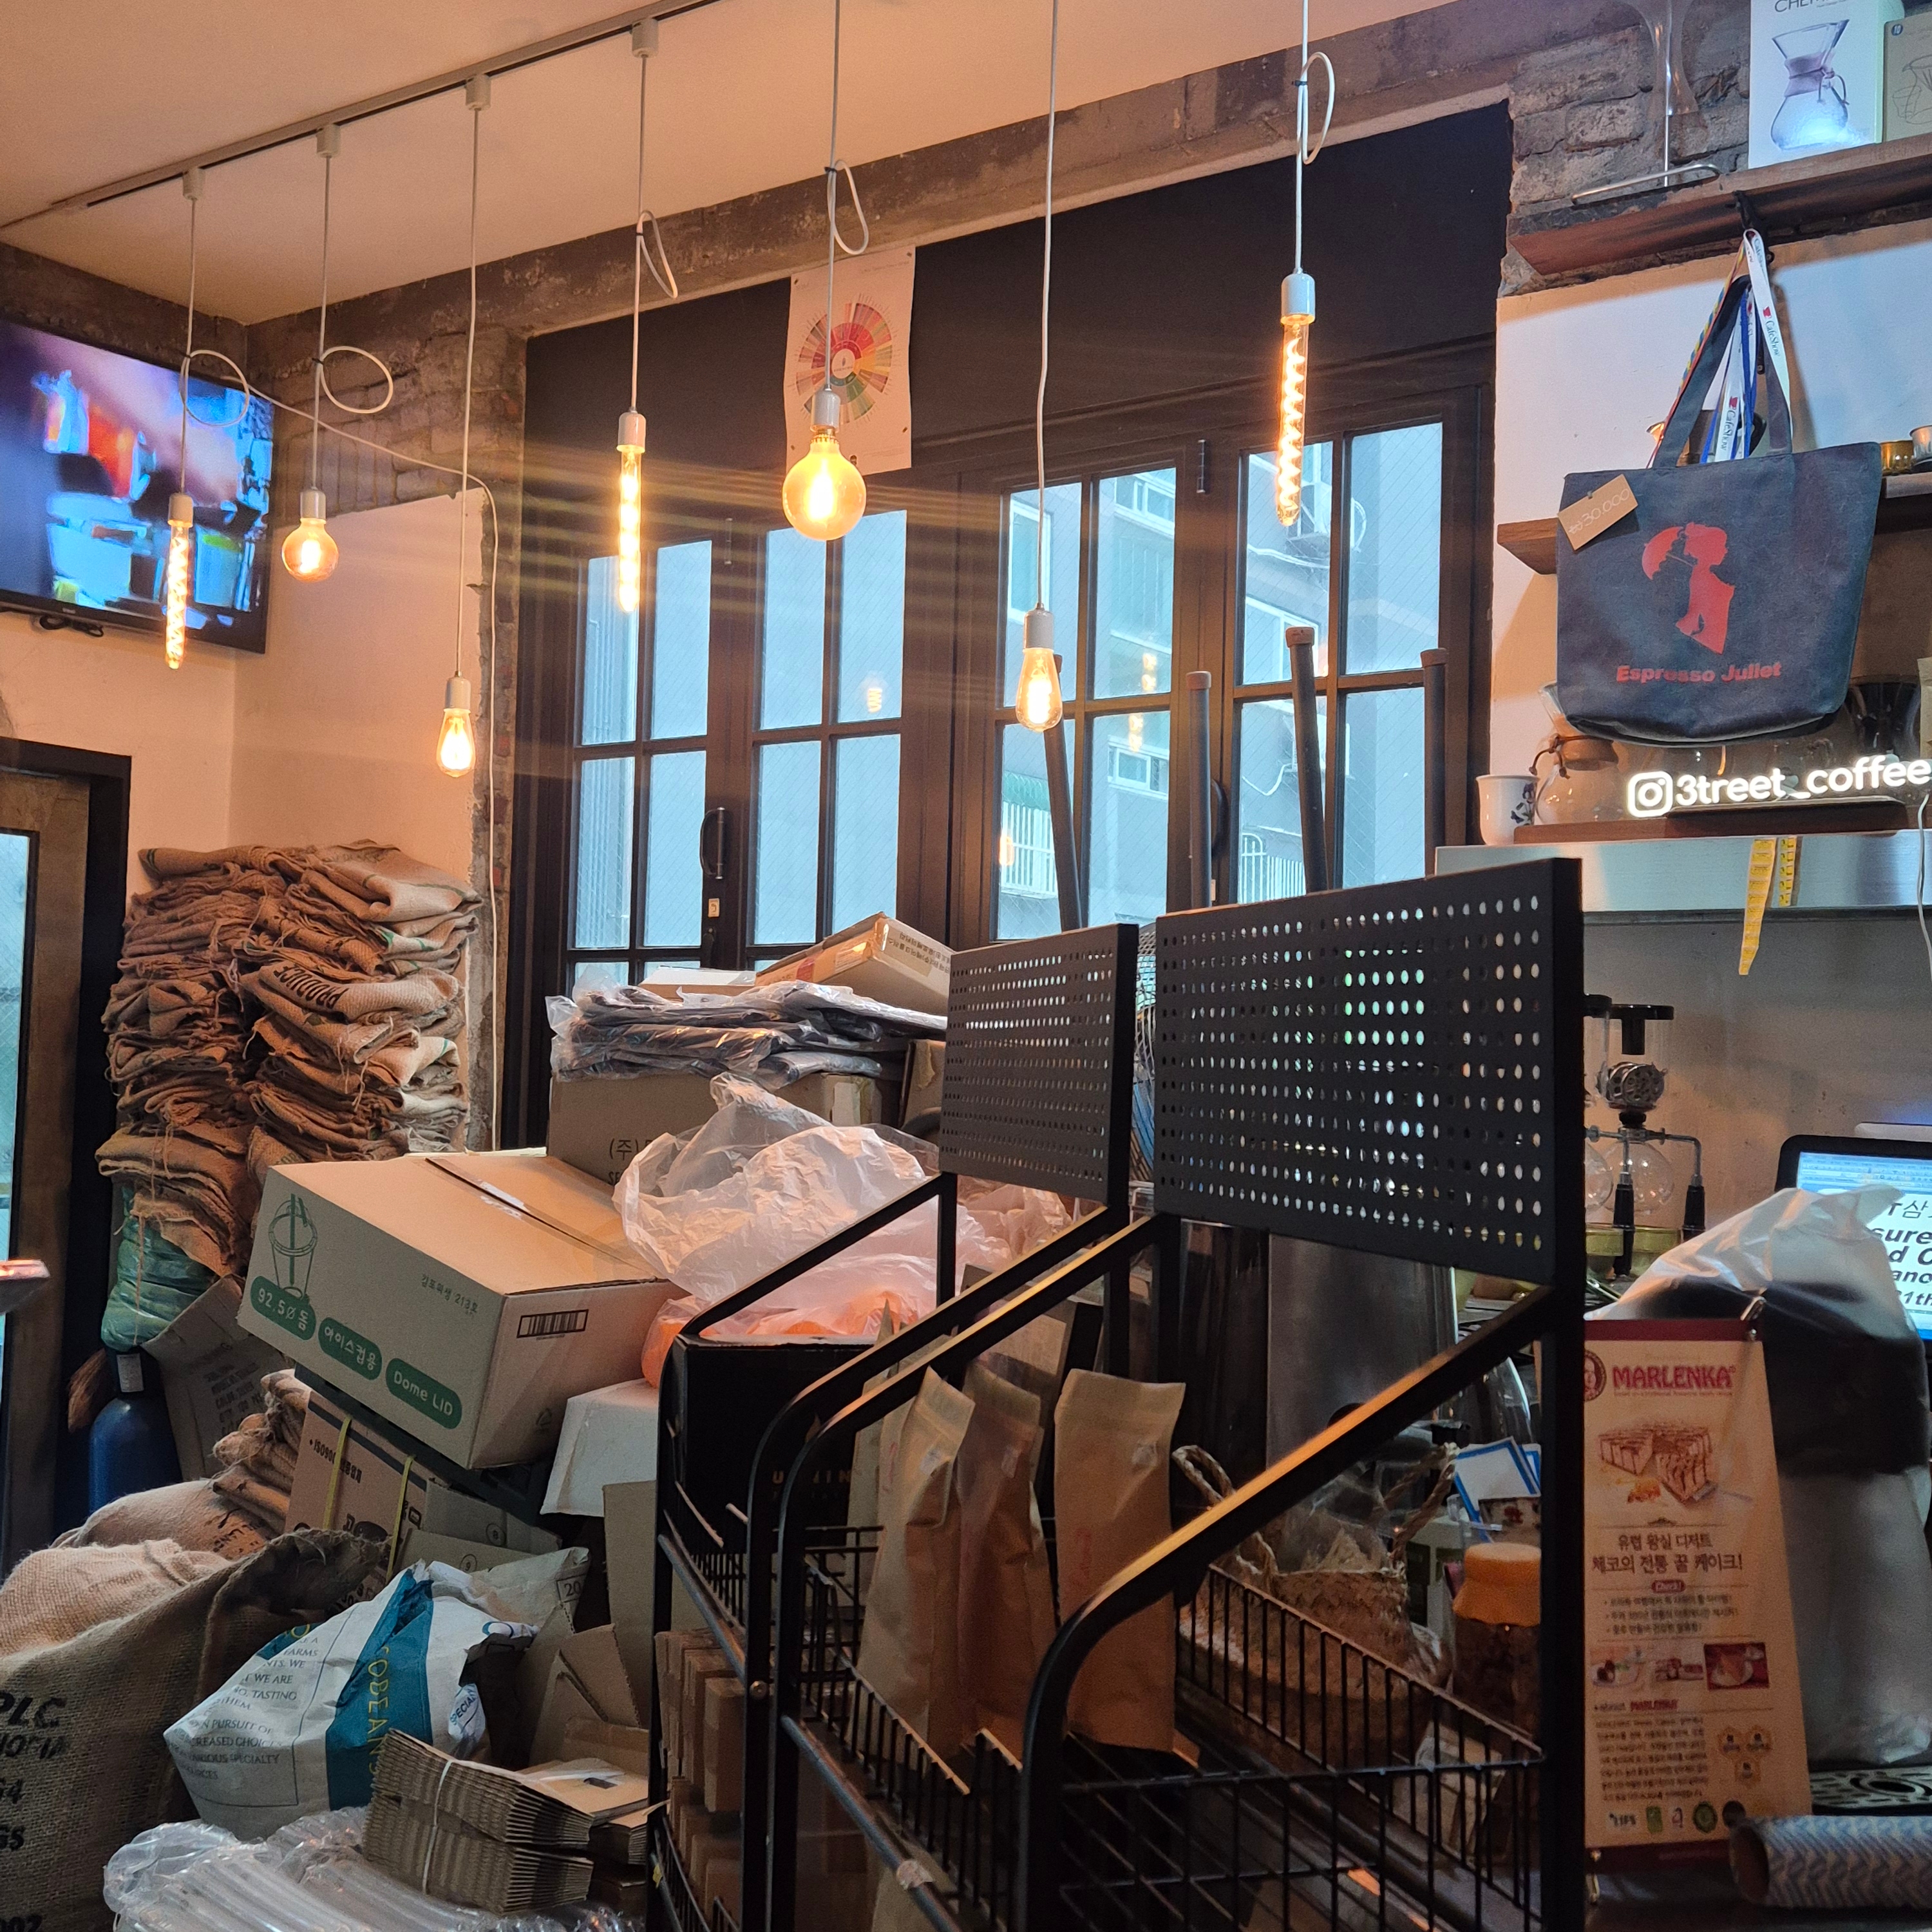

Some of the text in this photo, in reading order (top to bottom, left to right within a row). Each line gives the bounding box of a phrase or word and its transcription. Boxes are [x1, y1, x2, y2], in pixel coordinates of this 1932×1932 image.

[1765, 319, 1780, 356] CafeShow
[1720, 409, 1736, 451] CafeShow
[1616, 665, 1716, 683] Espresso
[1676, 755, 1932, 806] 3treet_coffee
[1613, 1365, 1733, 1390] MARLENKA
[393, 1370, 453, 1417] Dome LID
[1618, 1533, 1642, 1551] 유럽
[1592, 1553, 1635, 1574] 체코의
[289, 1659, 306, 1668] WE
[254, 1673, 270, 1681] WE
[272, 1675, 294, 1684] ARE
